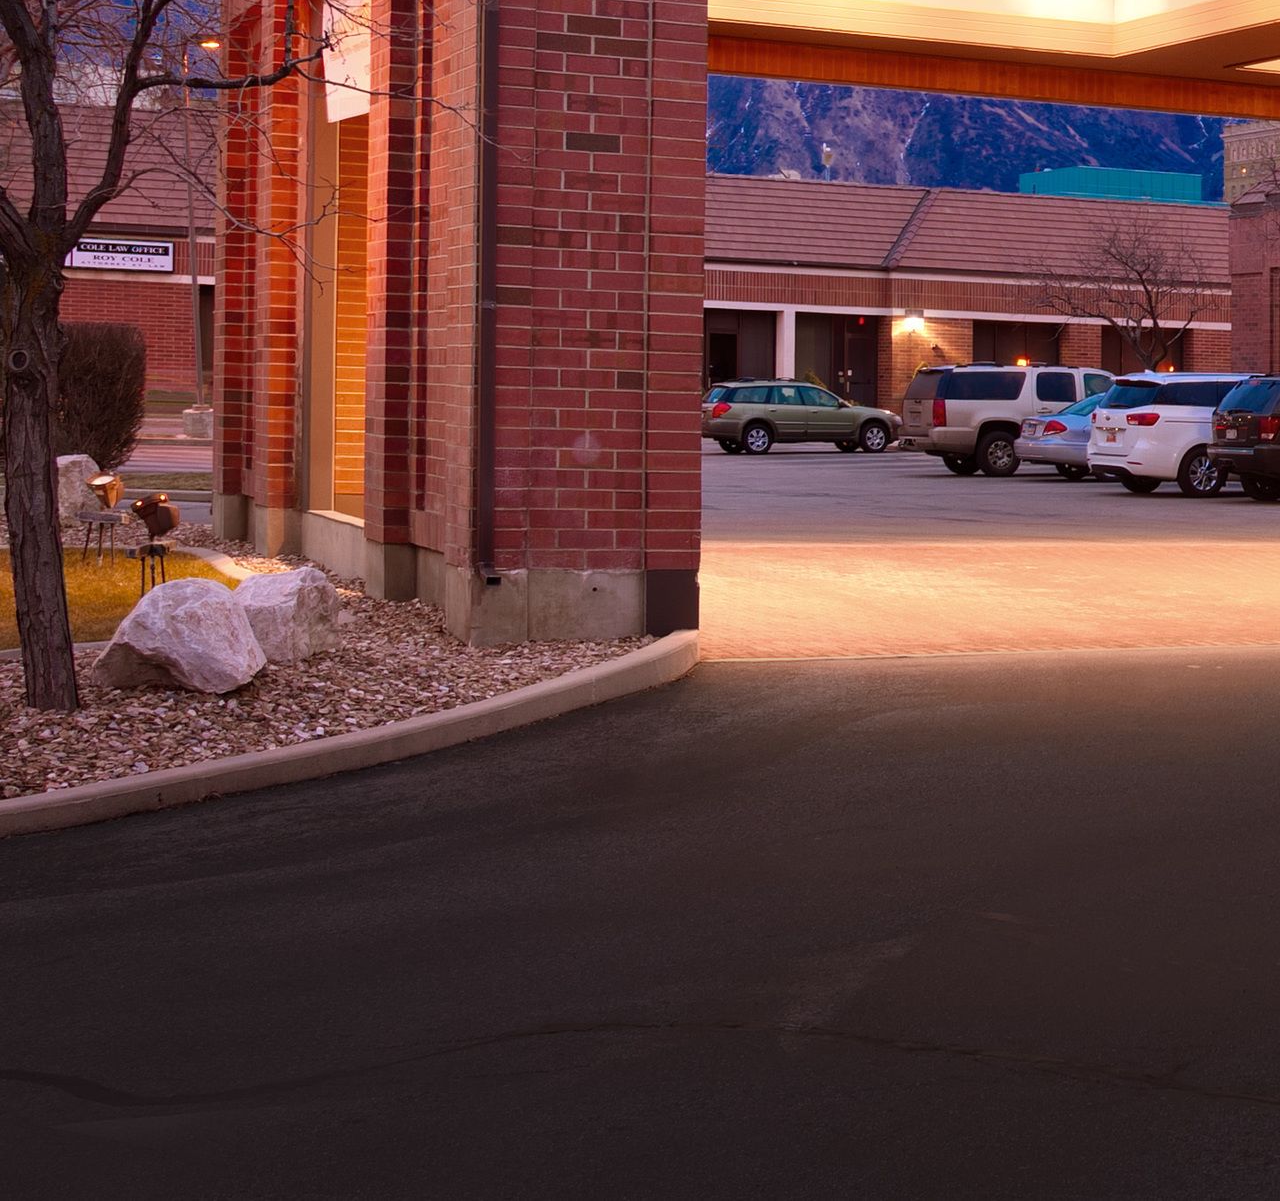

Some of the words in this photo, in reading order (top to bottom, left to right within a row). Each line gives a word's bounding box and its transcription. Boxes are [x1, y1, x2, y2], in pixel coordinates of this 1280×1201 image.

[80, 243, 106, 252] COLE
[108, 244, 130, 253] LAW
[131, 246, 165, 255] OFFICE
